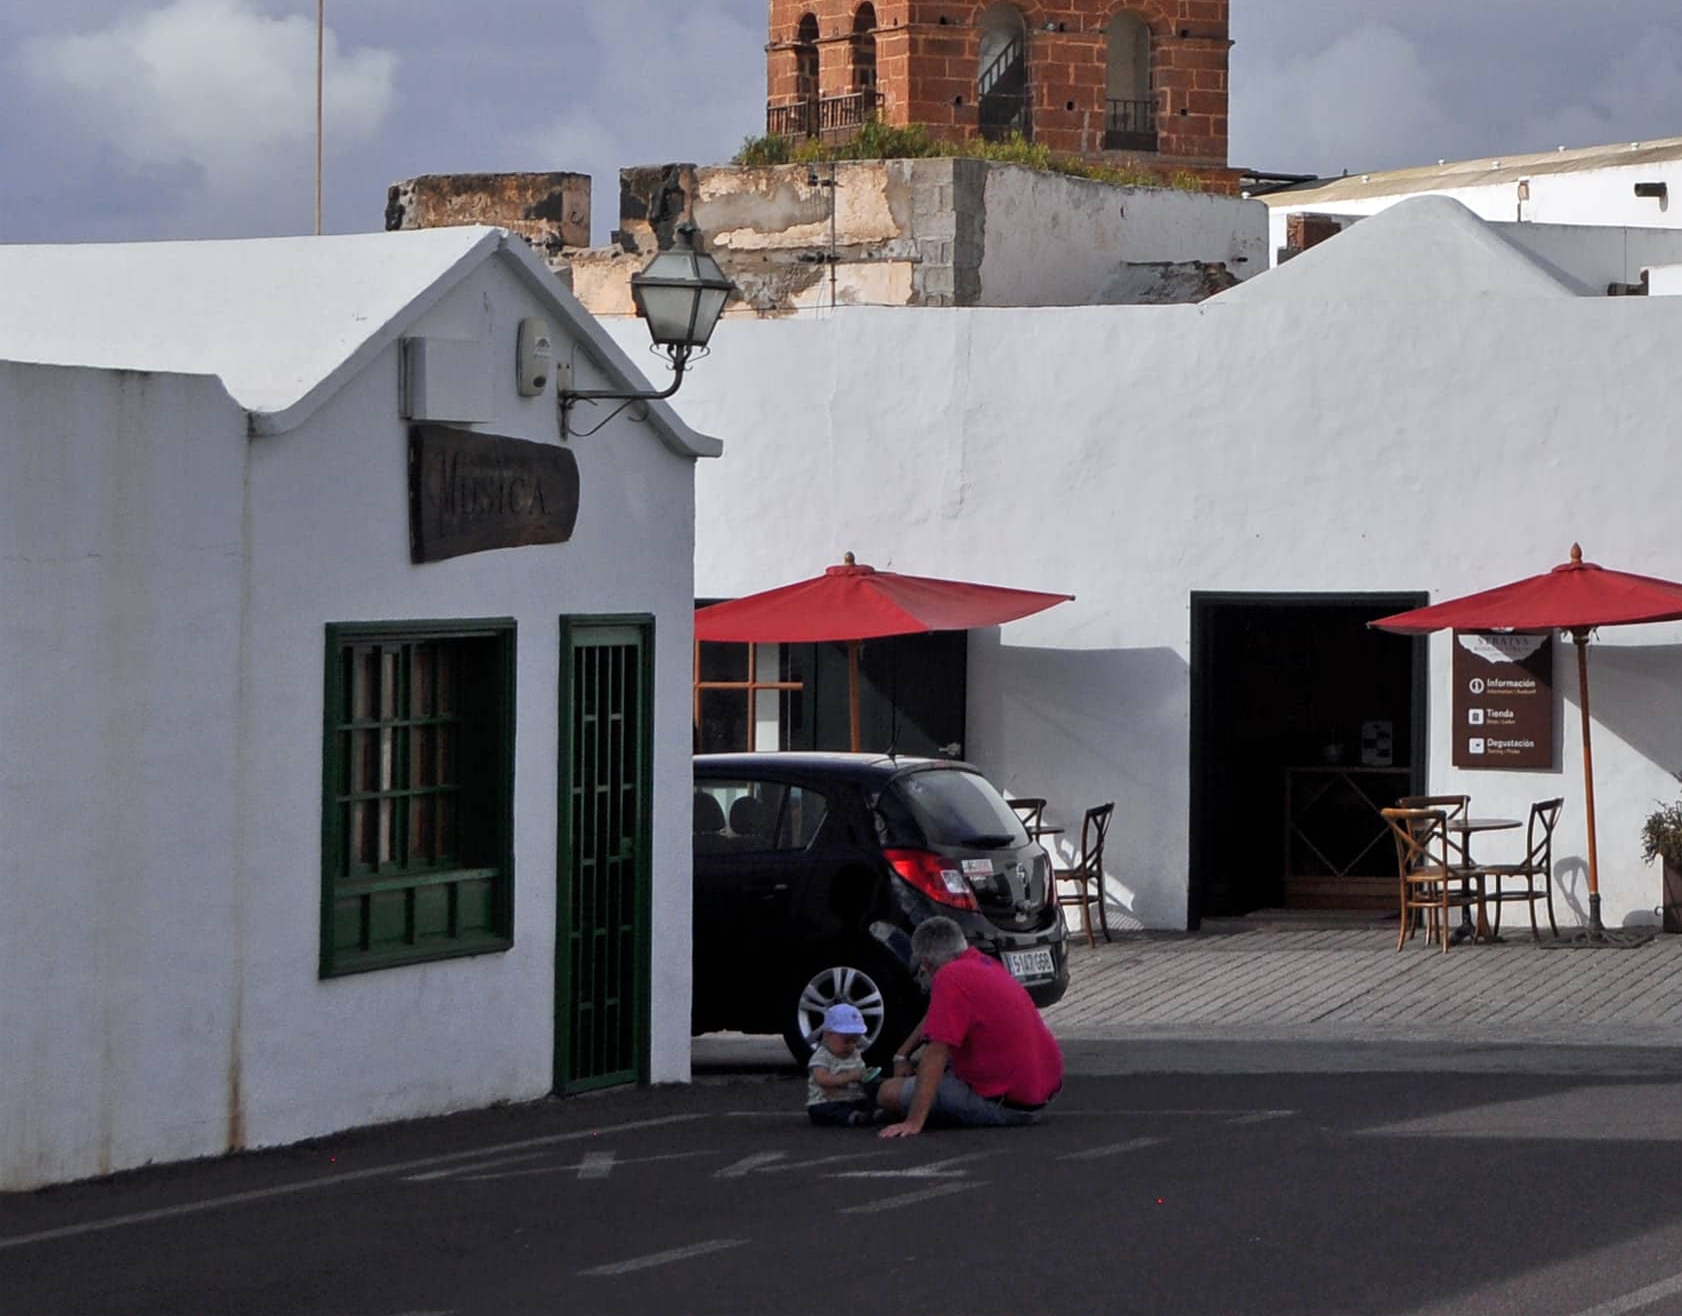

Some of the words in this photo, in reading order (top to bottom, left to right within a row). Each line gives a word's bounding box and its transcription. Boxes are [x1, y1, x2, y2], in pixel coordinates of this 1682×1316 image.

[1487, 678, 1536, 687] Información
[1486, 708, 1514, 718] Tienda
[1486, 738, 1535, 748] Degustación
